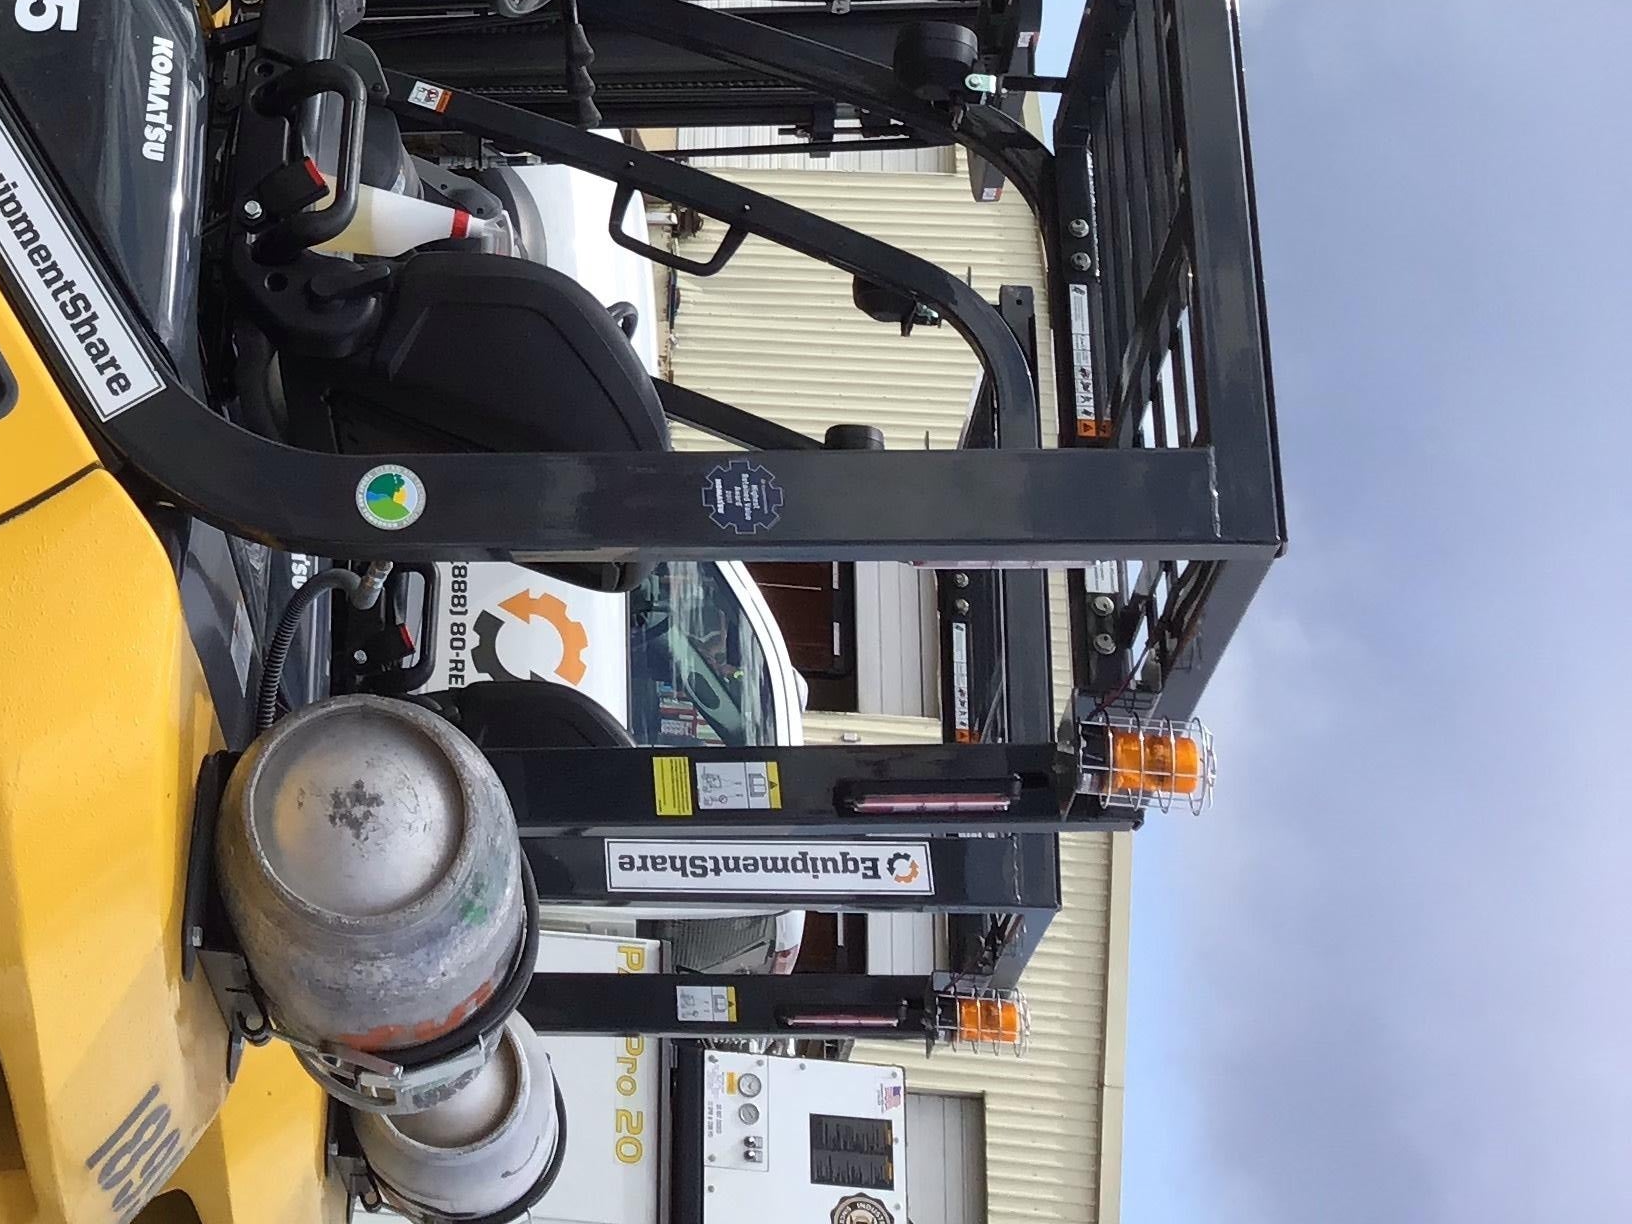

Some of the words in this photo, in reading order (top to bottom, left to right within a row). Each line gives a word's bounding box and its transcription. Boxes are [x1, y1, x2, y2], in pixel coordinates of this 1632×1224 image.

[142, 35, 175, 163] KOMATSU
[618, 852, 879, 879] EquipmentShare
[615, 1108, 644, 1165] 20
